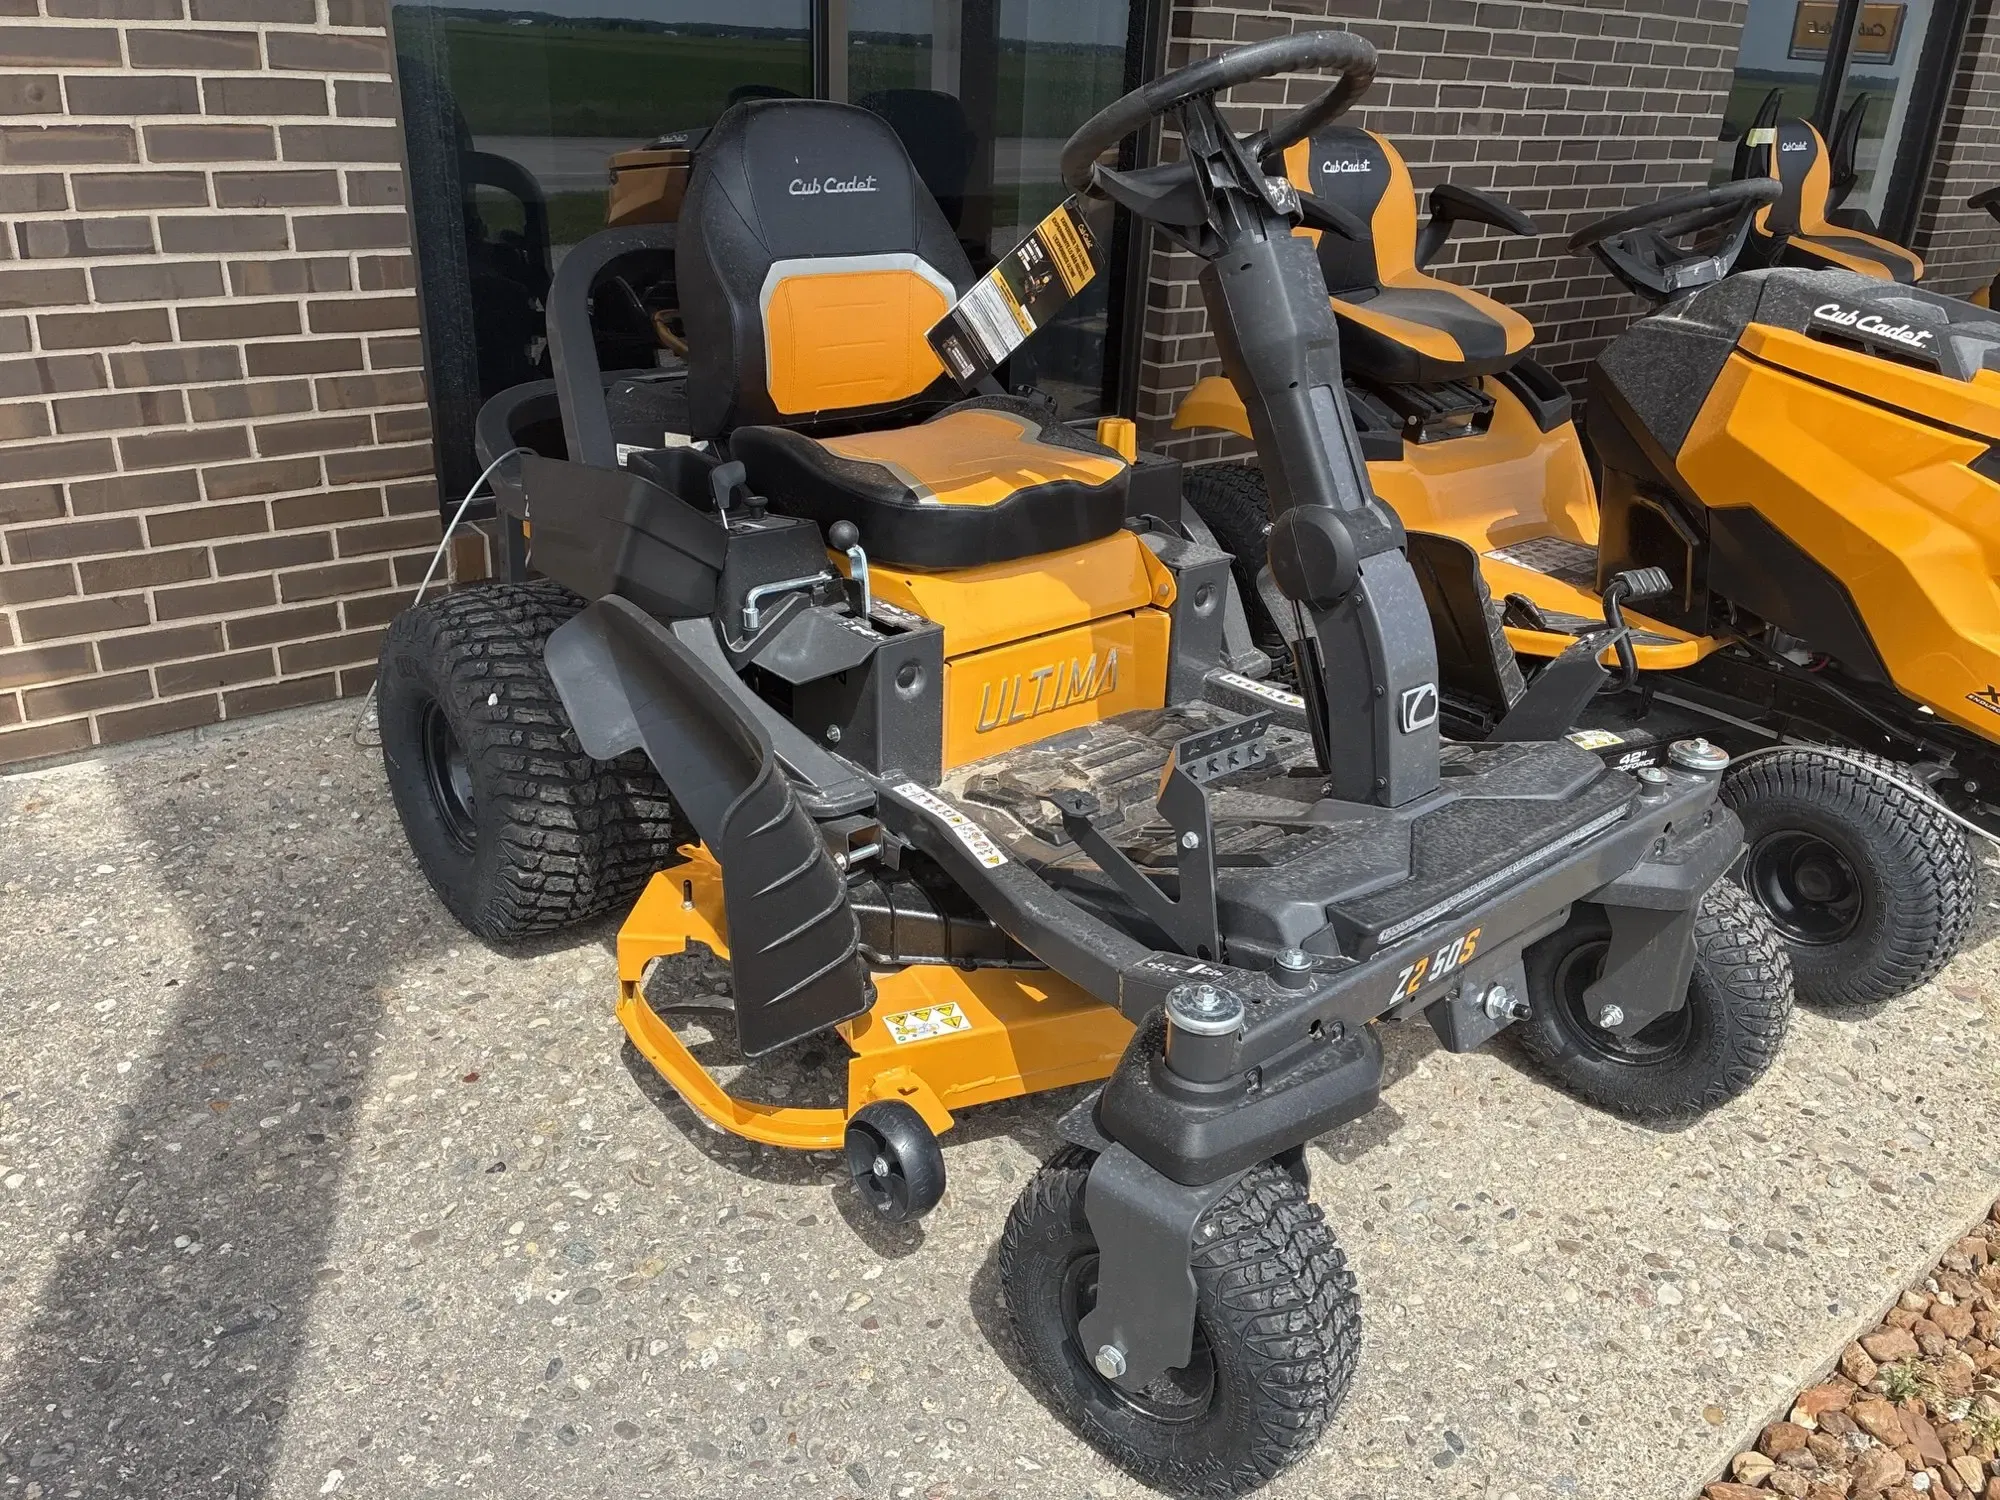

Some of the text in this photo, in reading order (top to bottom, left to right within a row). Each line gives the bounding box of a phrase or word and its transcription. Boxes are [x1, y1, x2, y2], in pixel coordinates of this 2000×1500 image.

[1322, 158, 1371, 173] Cub Cadet
[788, 175, 877, 195] Cub Cadet
[1814, 303, 1934, 348] Cub Cadet
[976, 647, 1119, 733] ULTIMA
[1619, 750, 1647, 765] 42"
[1389, 928, 1481, 1005] Z2 50S
